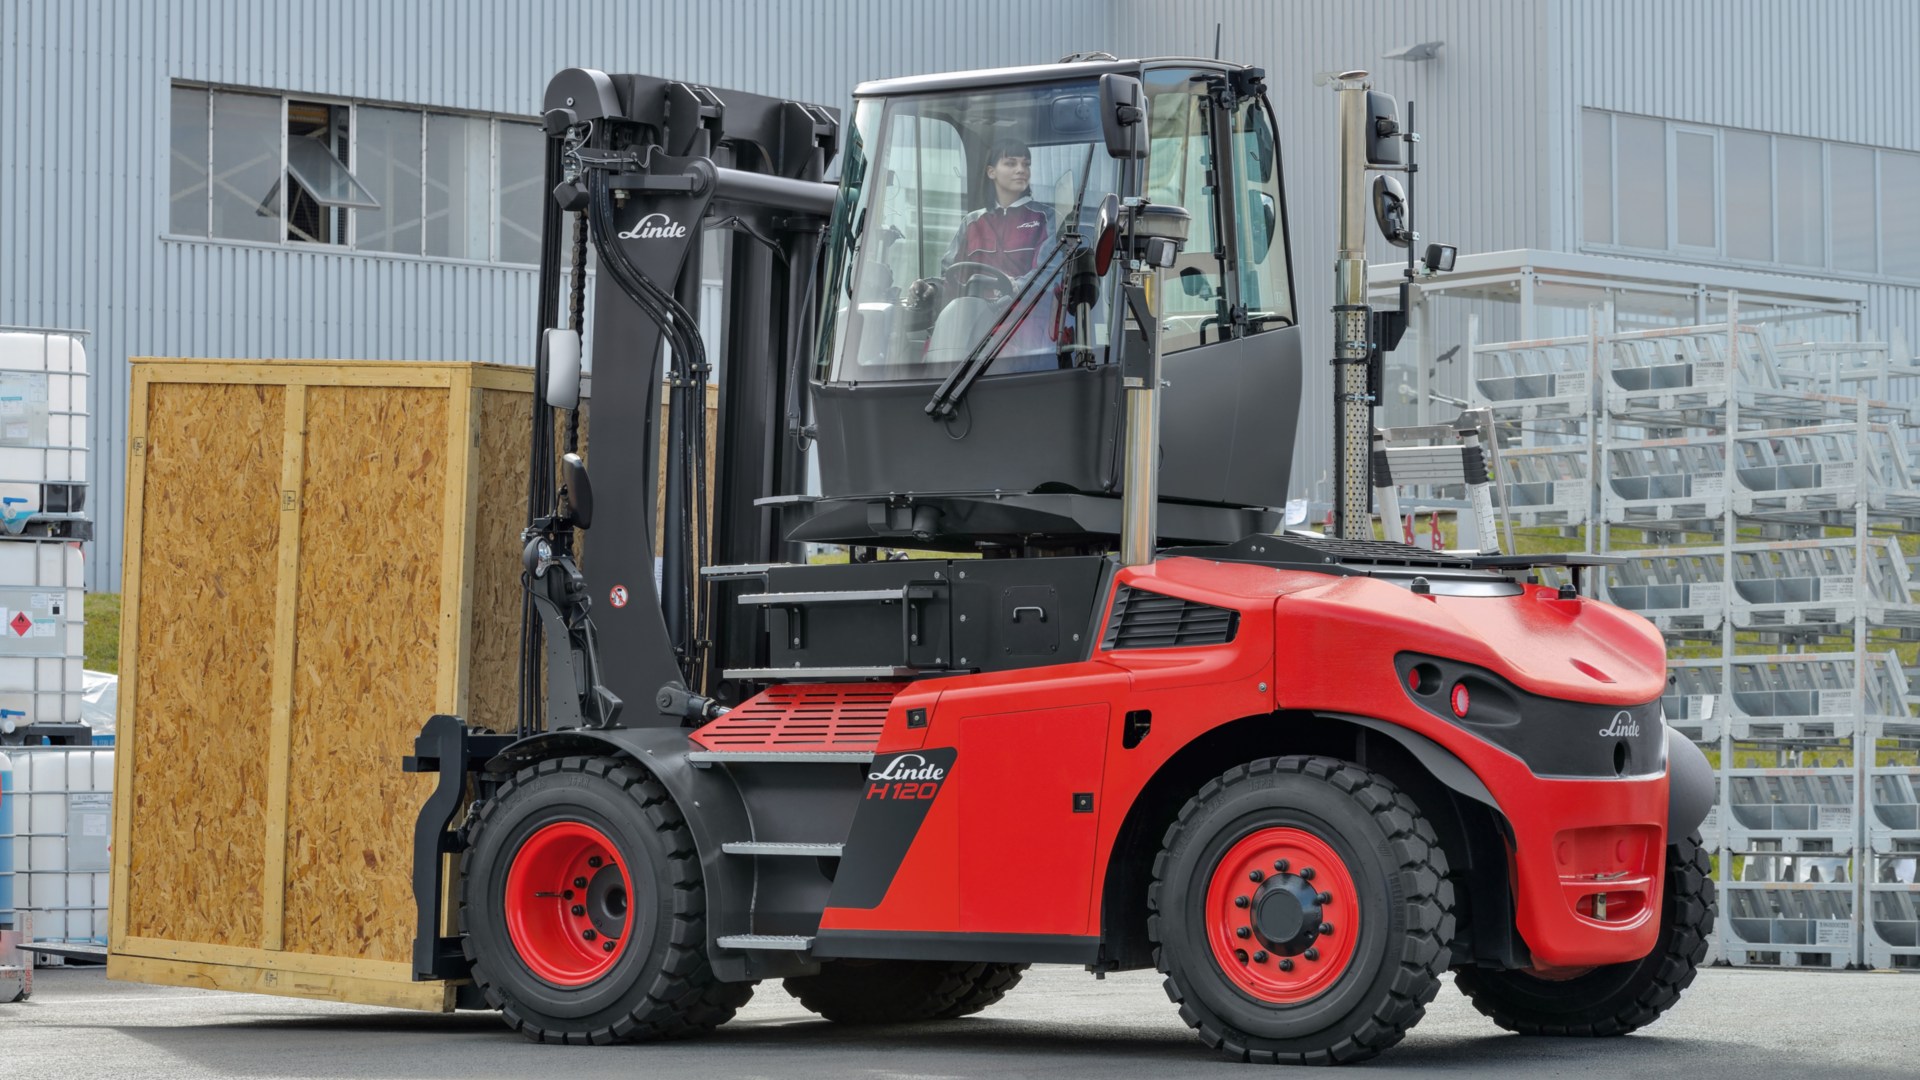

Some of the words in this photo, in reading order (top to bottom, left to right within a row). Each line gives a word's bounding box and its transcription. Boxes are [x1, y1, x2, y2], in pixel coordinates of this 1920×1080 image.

[617, 212, 687, 239] Linde
[1598, 710, 1640, 737] Linde
[868, 753, 944, 780] Linde
[866, 782, 890, 800] H
[892, 782, 938, 800] 120
